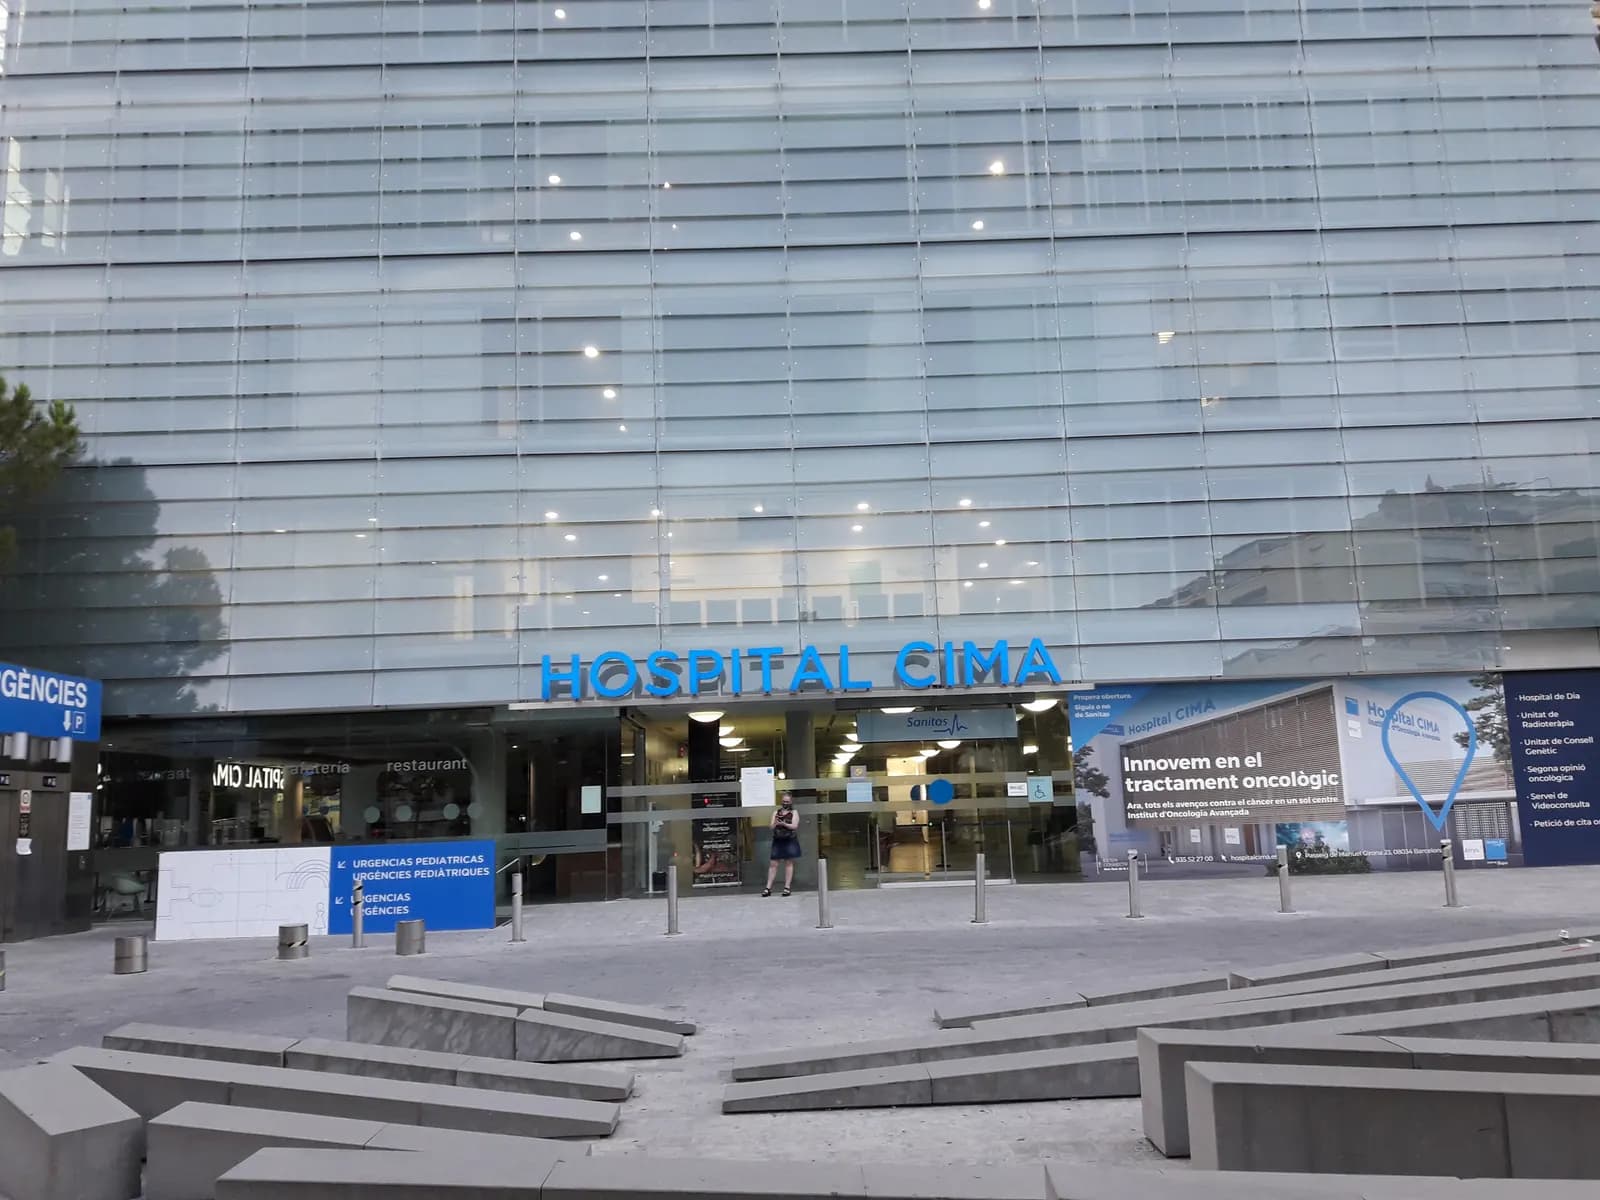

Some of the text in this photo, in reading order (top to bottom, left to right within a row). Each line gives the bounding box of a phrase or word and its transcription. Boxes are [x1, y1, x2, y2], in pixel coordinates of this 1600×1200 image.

[541, 637, 1062, 700] HOSPITAL CIMA
[0, 667, 88, 708] GÈNCIES
[1519, 693, 1553, 702] Hospital
[1566, 692, 1580, 700] Dia
[1128, 711, 1172, 736] Hospital
[1175, 698, 1216, 721] CIMA
[1520, 711, 1547, 719] Unitat
[75, 715, 82, 729] P
[907, 716, 948, 728] Sanitas
[1416, 717, 1440, 733] CIMA
[1522, 719, 1574, 728] Radioteràpia
[1524, 736, 1594, 746] Unitat de Consell
[1525, 747, 1558, 756] Genètic
[387, 757, 468, 772] restaurant
[1123, 752, 1262, 772] Innovem en el
[1527, 763, 1586, 774] Segona opinió
[1125, 769, 1339, 793] tractament oncològic
[1528, 774, 1574, 783] oncològica
[1530, 792, 1556, 800] Servei
[1127, 802, 1143, 810] Ara,
[1144, 801, 1161, 809] tots
[1162, 800, 1174, 808] els
[1175, 801, 1209, 810] avenços
[1209, 799, 1237, 807] contra
[1238, 798, 1245, 806] el
[1246, 797, 1274, 806] càncer
[1298, 796, 1311, 804] sol
[1311, 796, 1338, 804] centre
[1531, 800, 1590, 810] Videoconsulta
[1127, 808, 1249, 819] Institut d'Oncologia Avançada
[1534, 819, 1563, 828] Petició
[1576, 818, 1592, 826] cita
[353, 855, 484, 868] URGENCIAS PEDIATRICAS
[352, 866, 490, 881] URGÈNCIES PEDIÀTRIQUES
